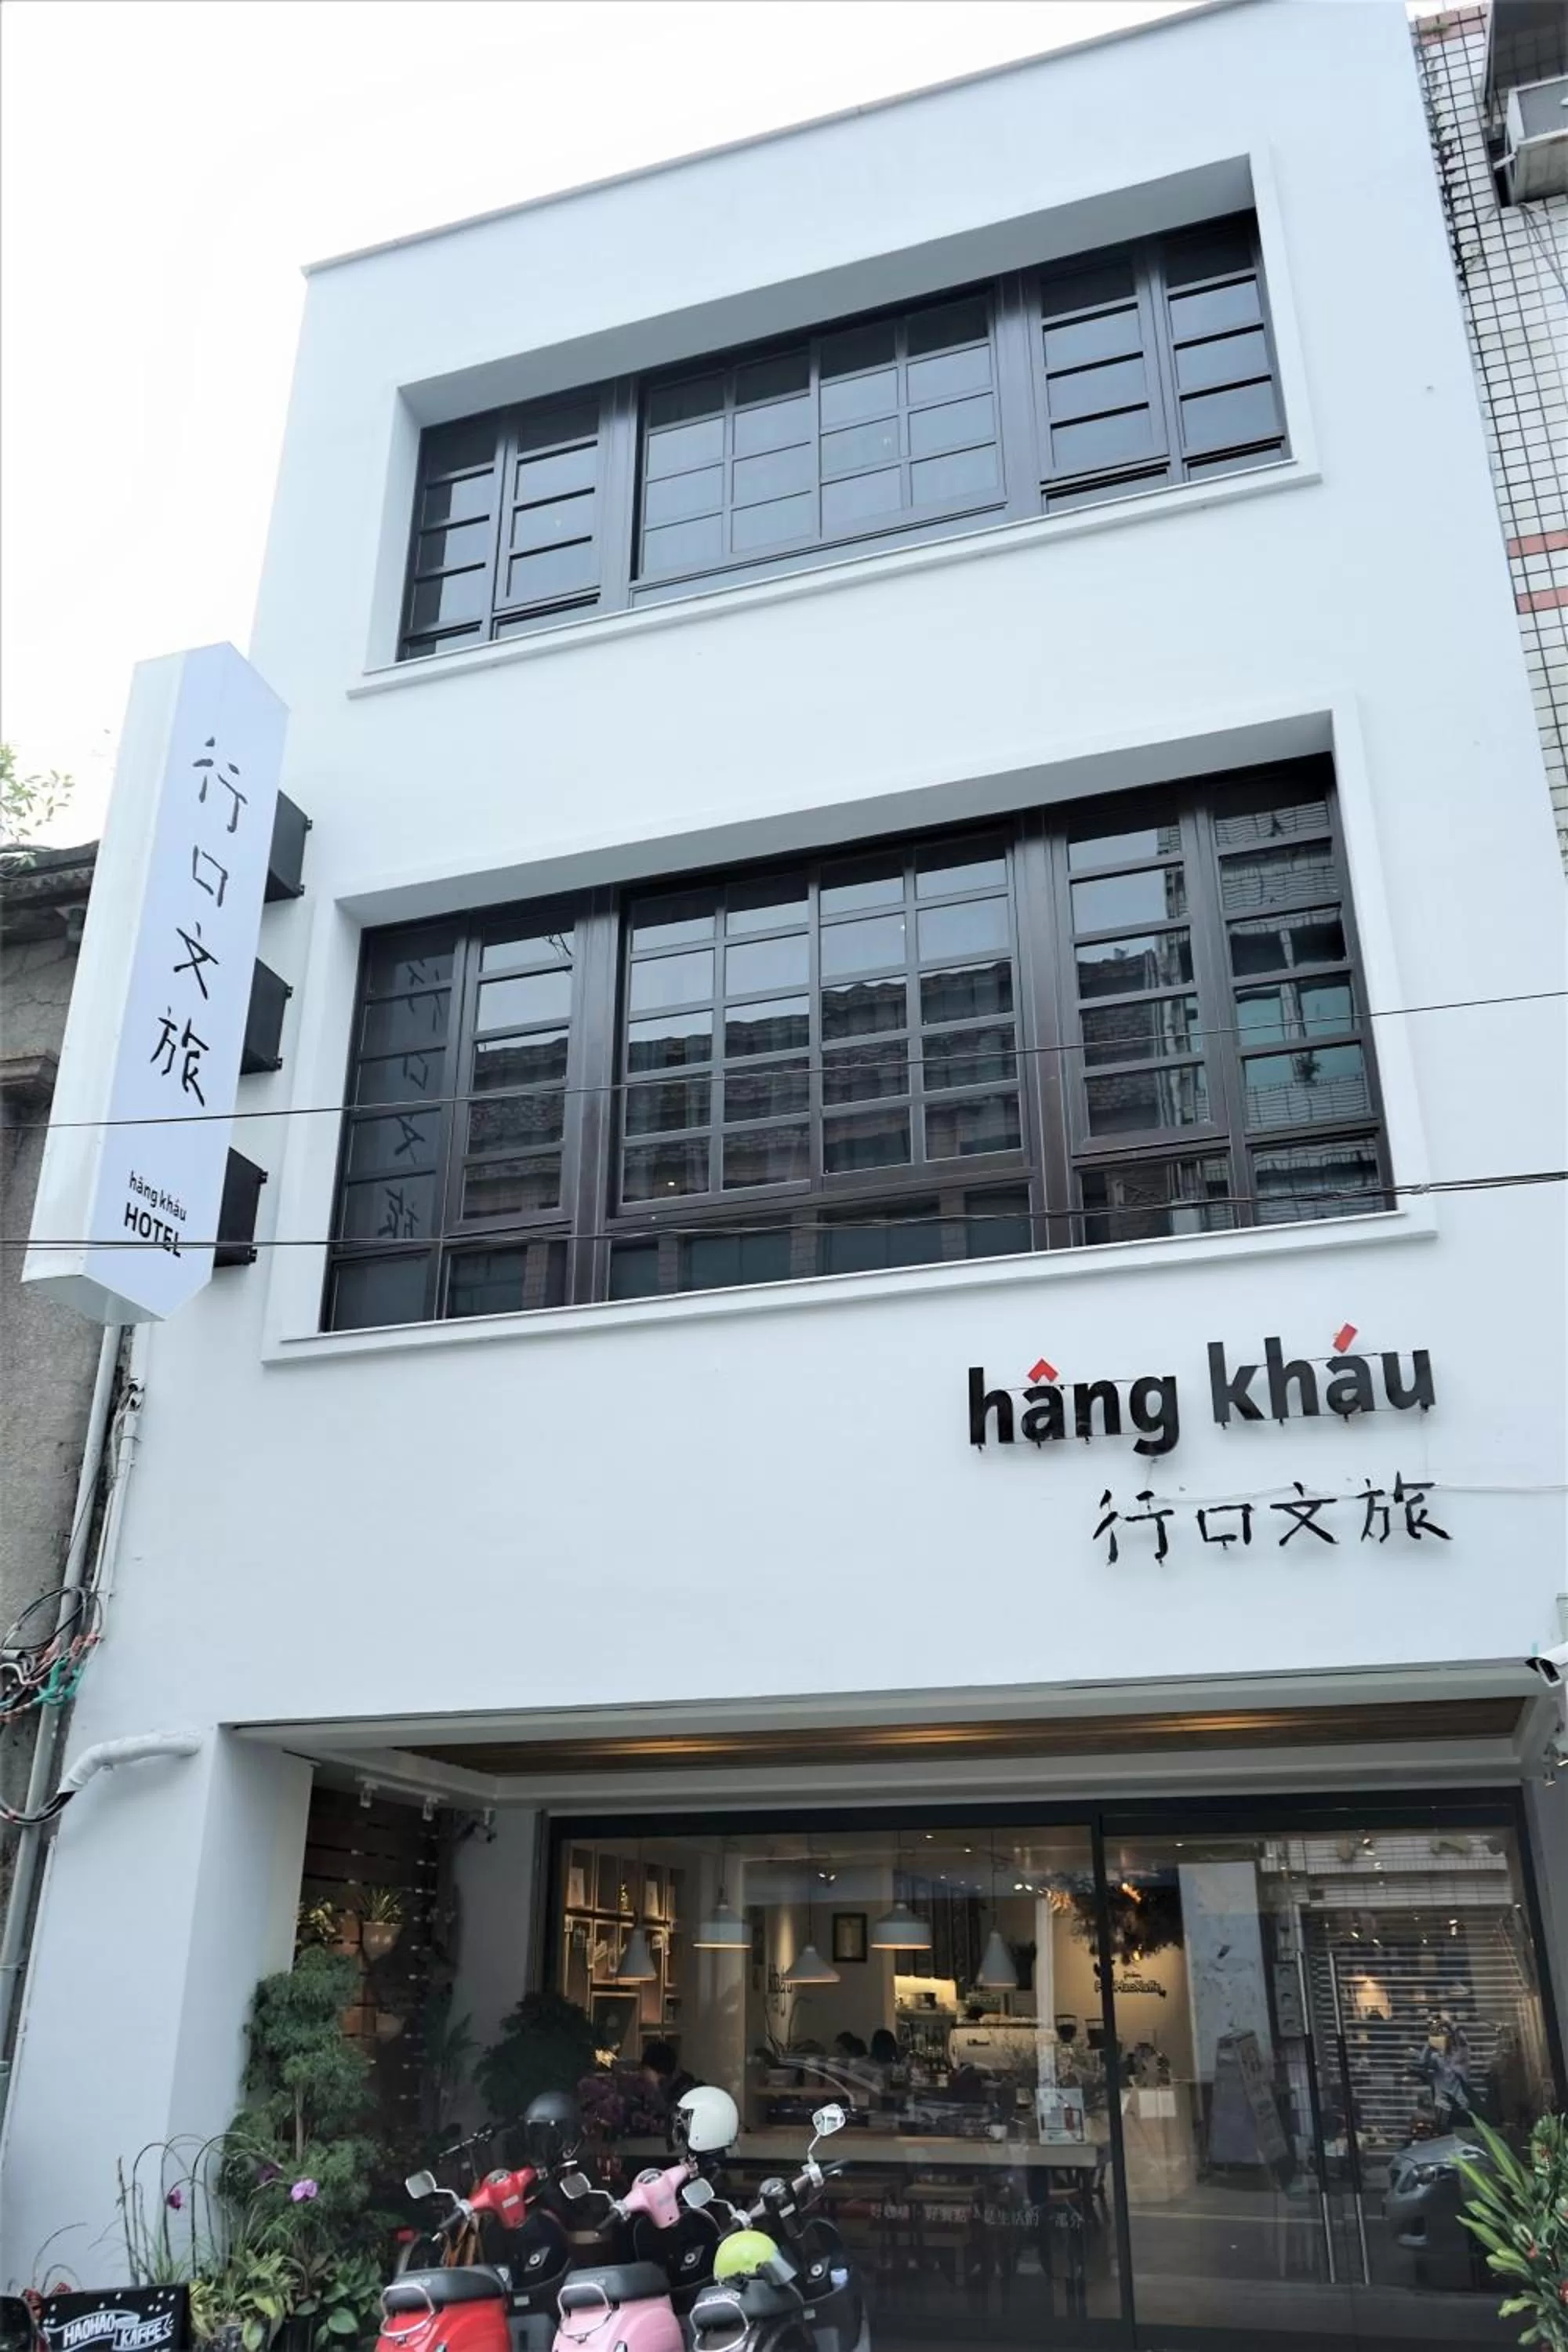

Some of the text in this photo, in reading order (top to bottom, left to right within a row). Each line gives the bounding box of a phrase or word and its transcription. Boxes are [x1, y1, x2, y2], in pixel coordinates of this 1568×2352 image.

[151, 737, 249, 1107] 行口文旅
[124, 1202, 181, 1258] HOTEL
[968, 1358, 1179, 1456] hâng
[1093, 1471, 1452, 1564] 行口文旅
